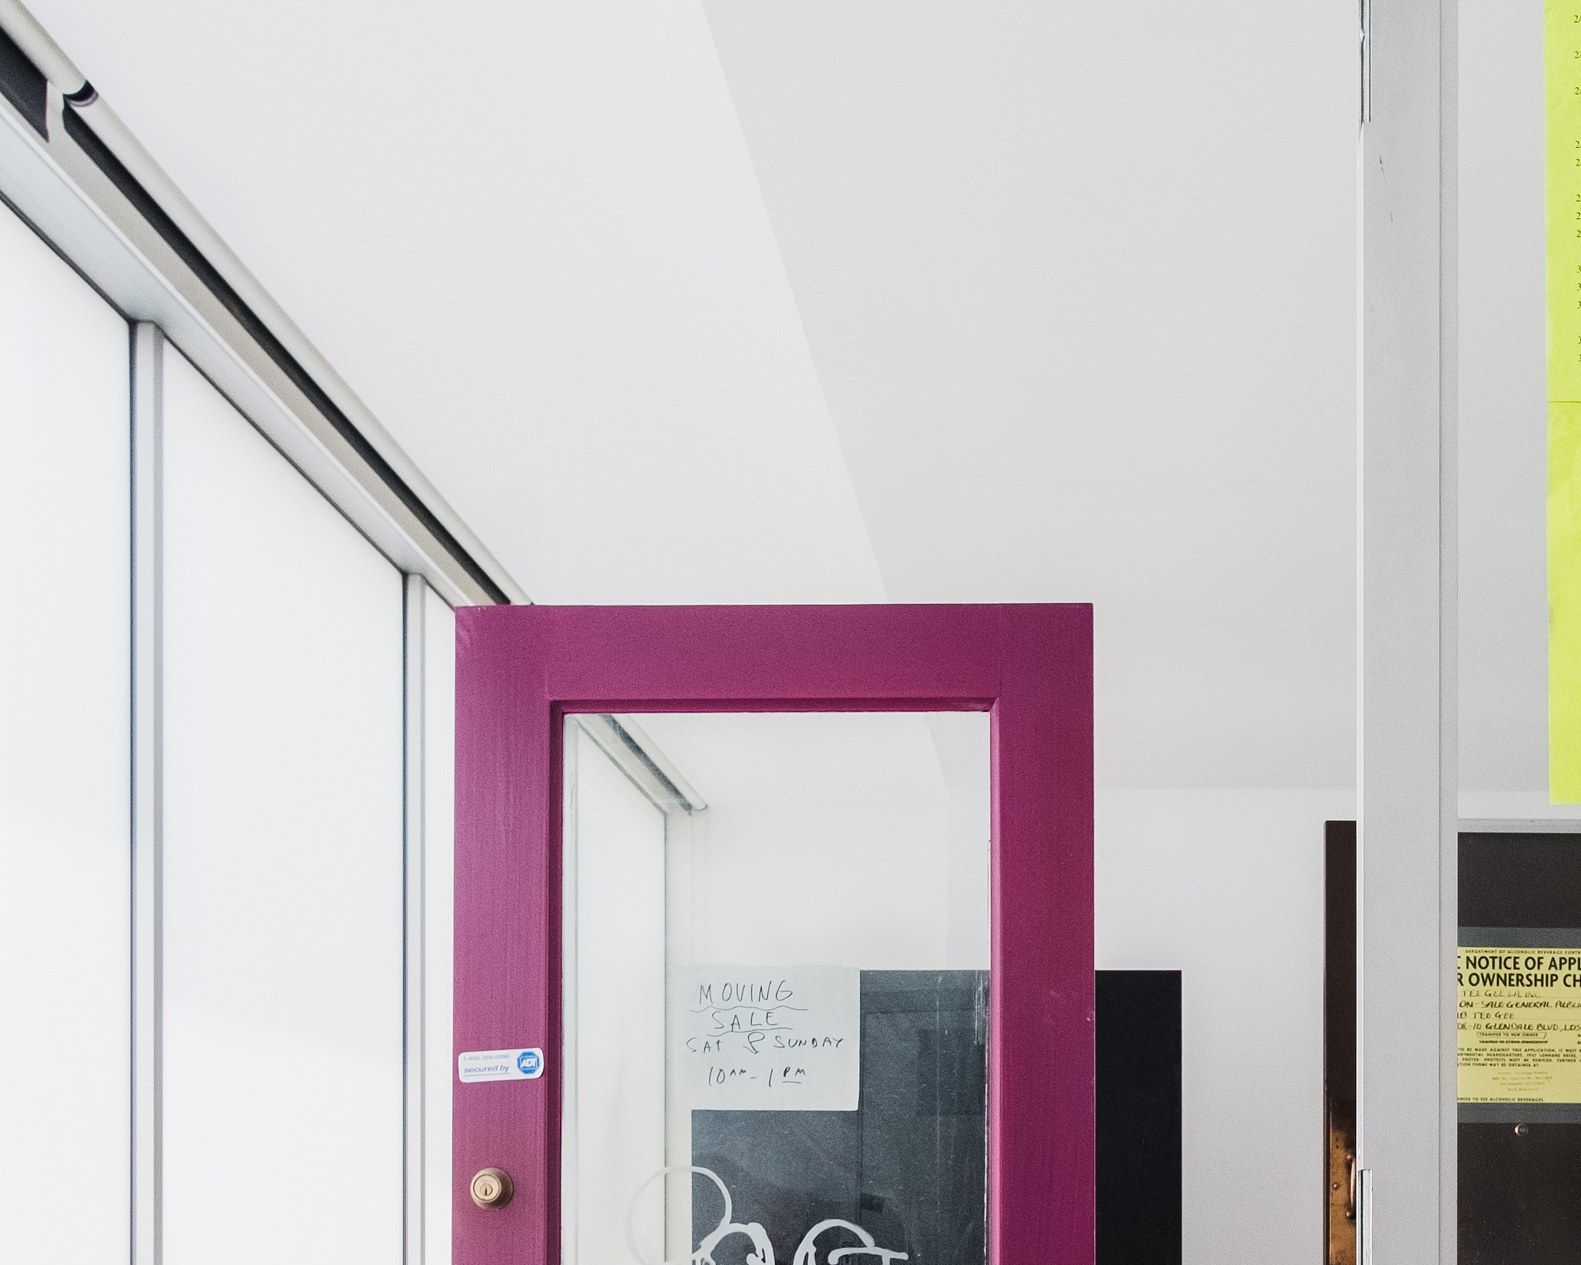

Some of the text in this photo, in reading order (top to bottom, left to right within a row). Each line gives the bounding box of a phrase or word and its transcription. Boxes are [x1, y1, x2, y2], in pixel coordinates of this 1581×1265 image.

[1465, 955, 1521, 971] NOTICE
[1524, 956, 1545, 971] OF
[1468, 972, 1559, 988] OWNERSHIP
[699, 980, 794, 1005] MOVING
[711, 1010, 779, 1032] SALE
[1485, 1023, 1535, 1031] GLENDALE
[686, 1036, 723, 1054] SAT
[773, 1034, 845, 1049] SUNDAY
